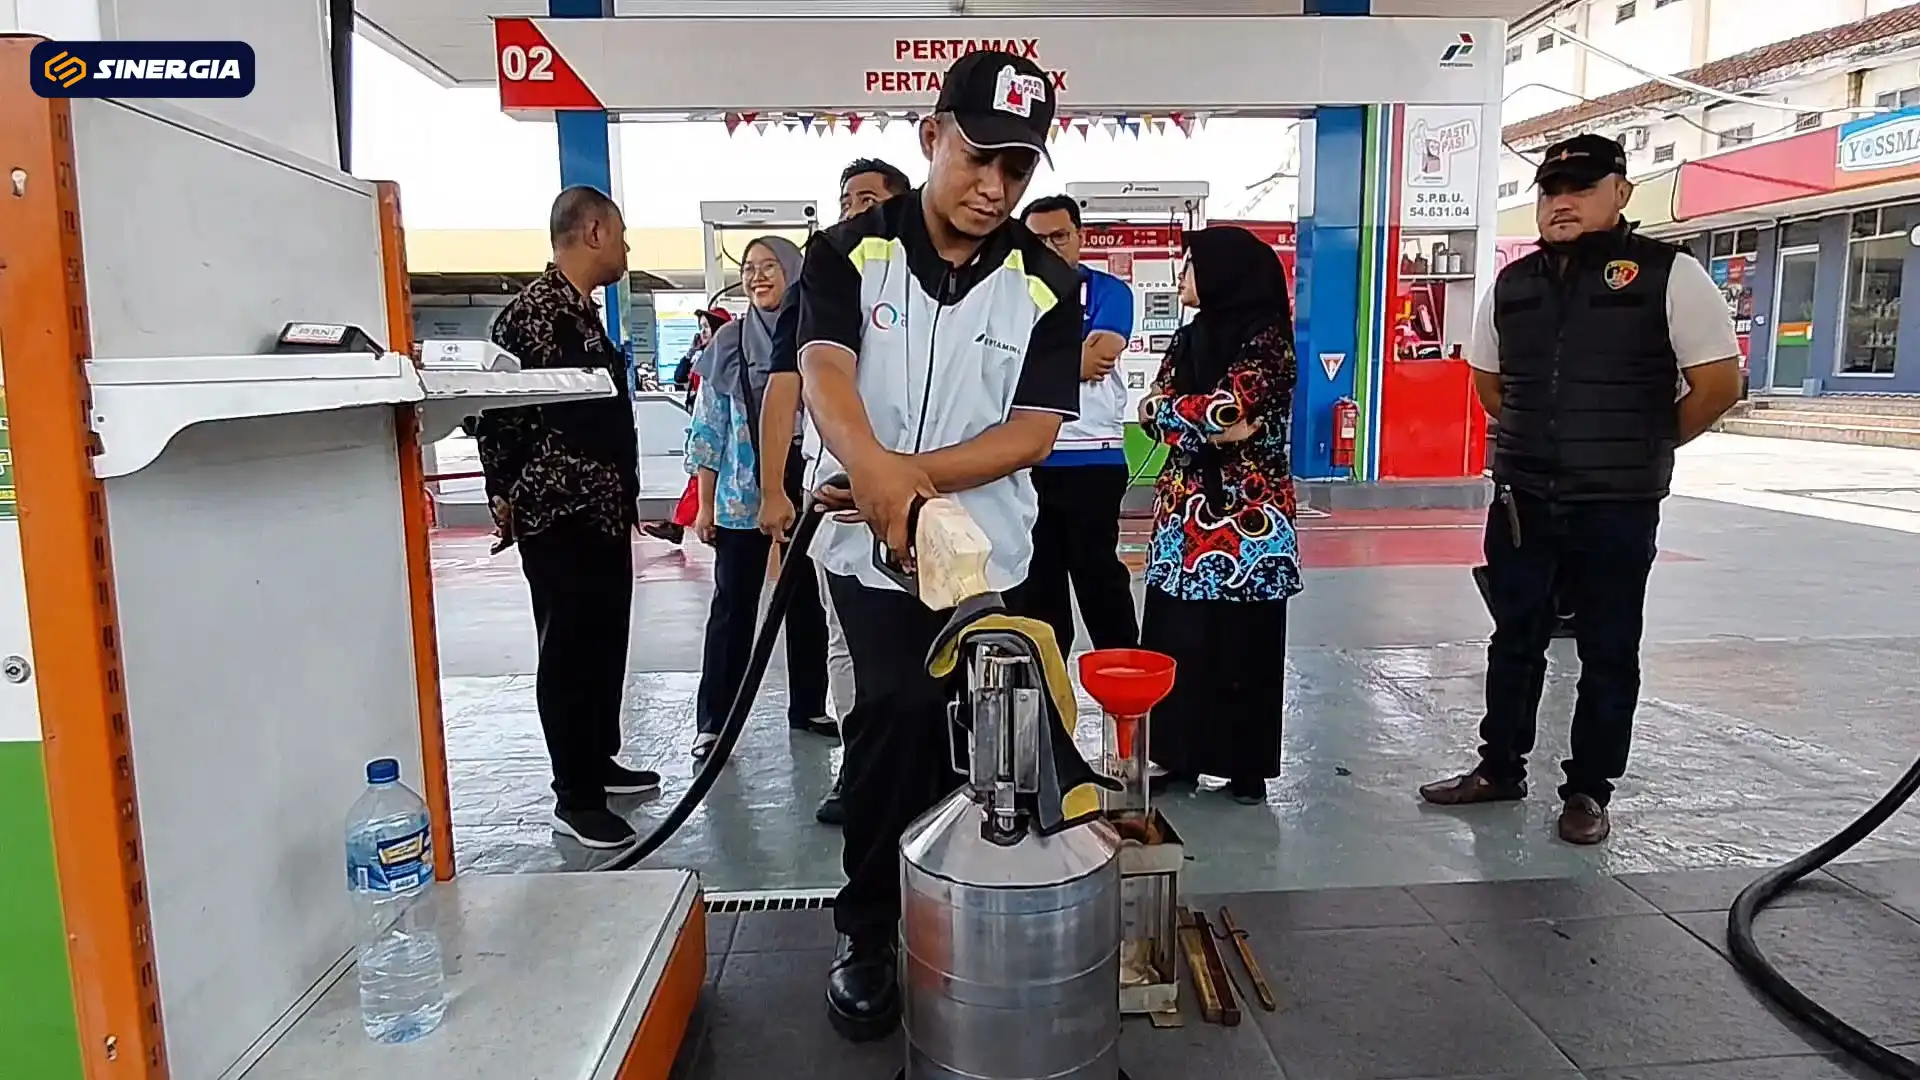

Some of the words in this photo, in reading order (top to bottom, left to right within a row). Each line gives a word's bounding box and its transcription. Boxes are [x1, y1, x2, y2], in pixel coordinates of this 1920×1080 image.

[896, 39, 1039, 59] PERTAMAX
[502, 45, 554, 81] 02
[1440, 123, 1469, 141] PASTI
[1416, 193, 1464, 203] S.P.B.U.
[1409, 206, 1470, 218] 54.631.04
